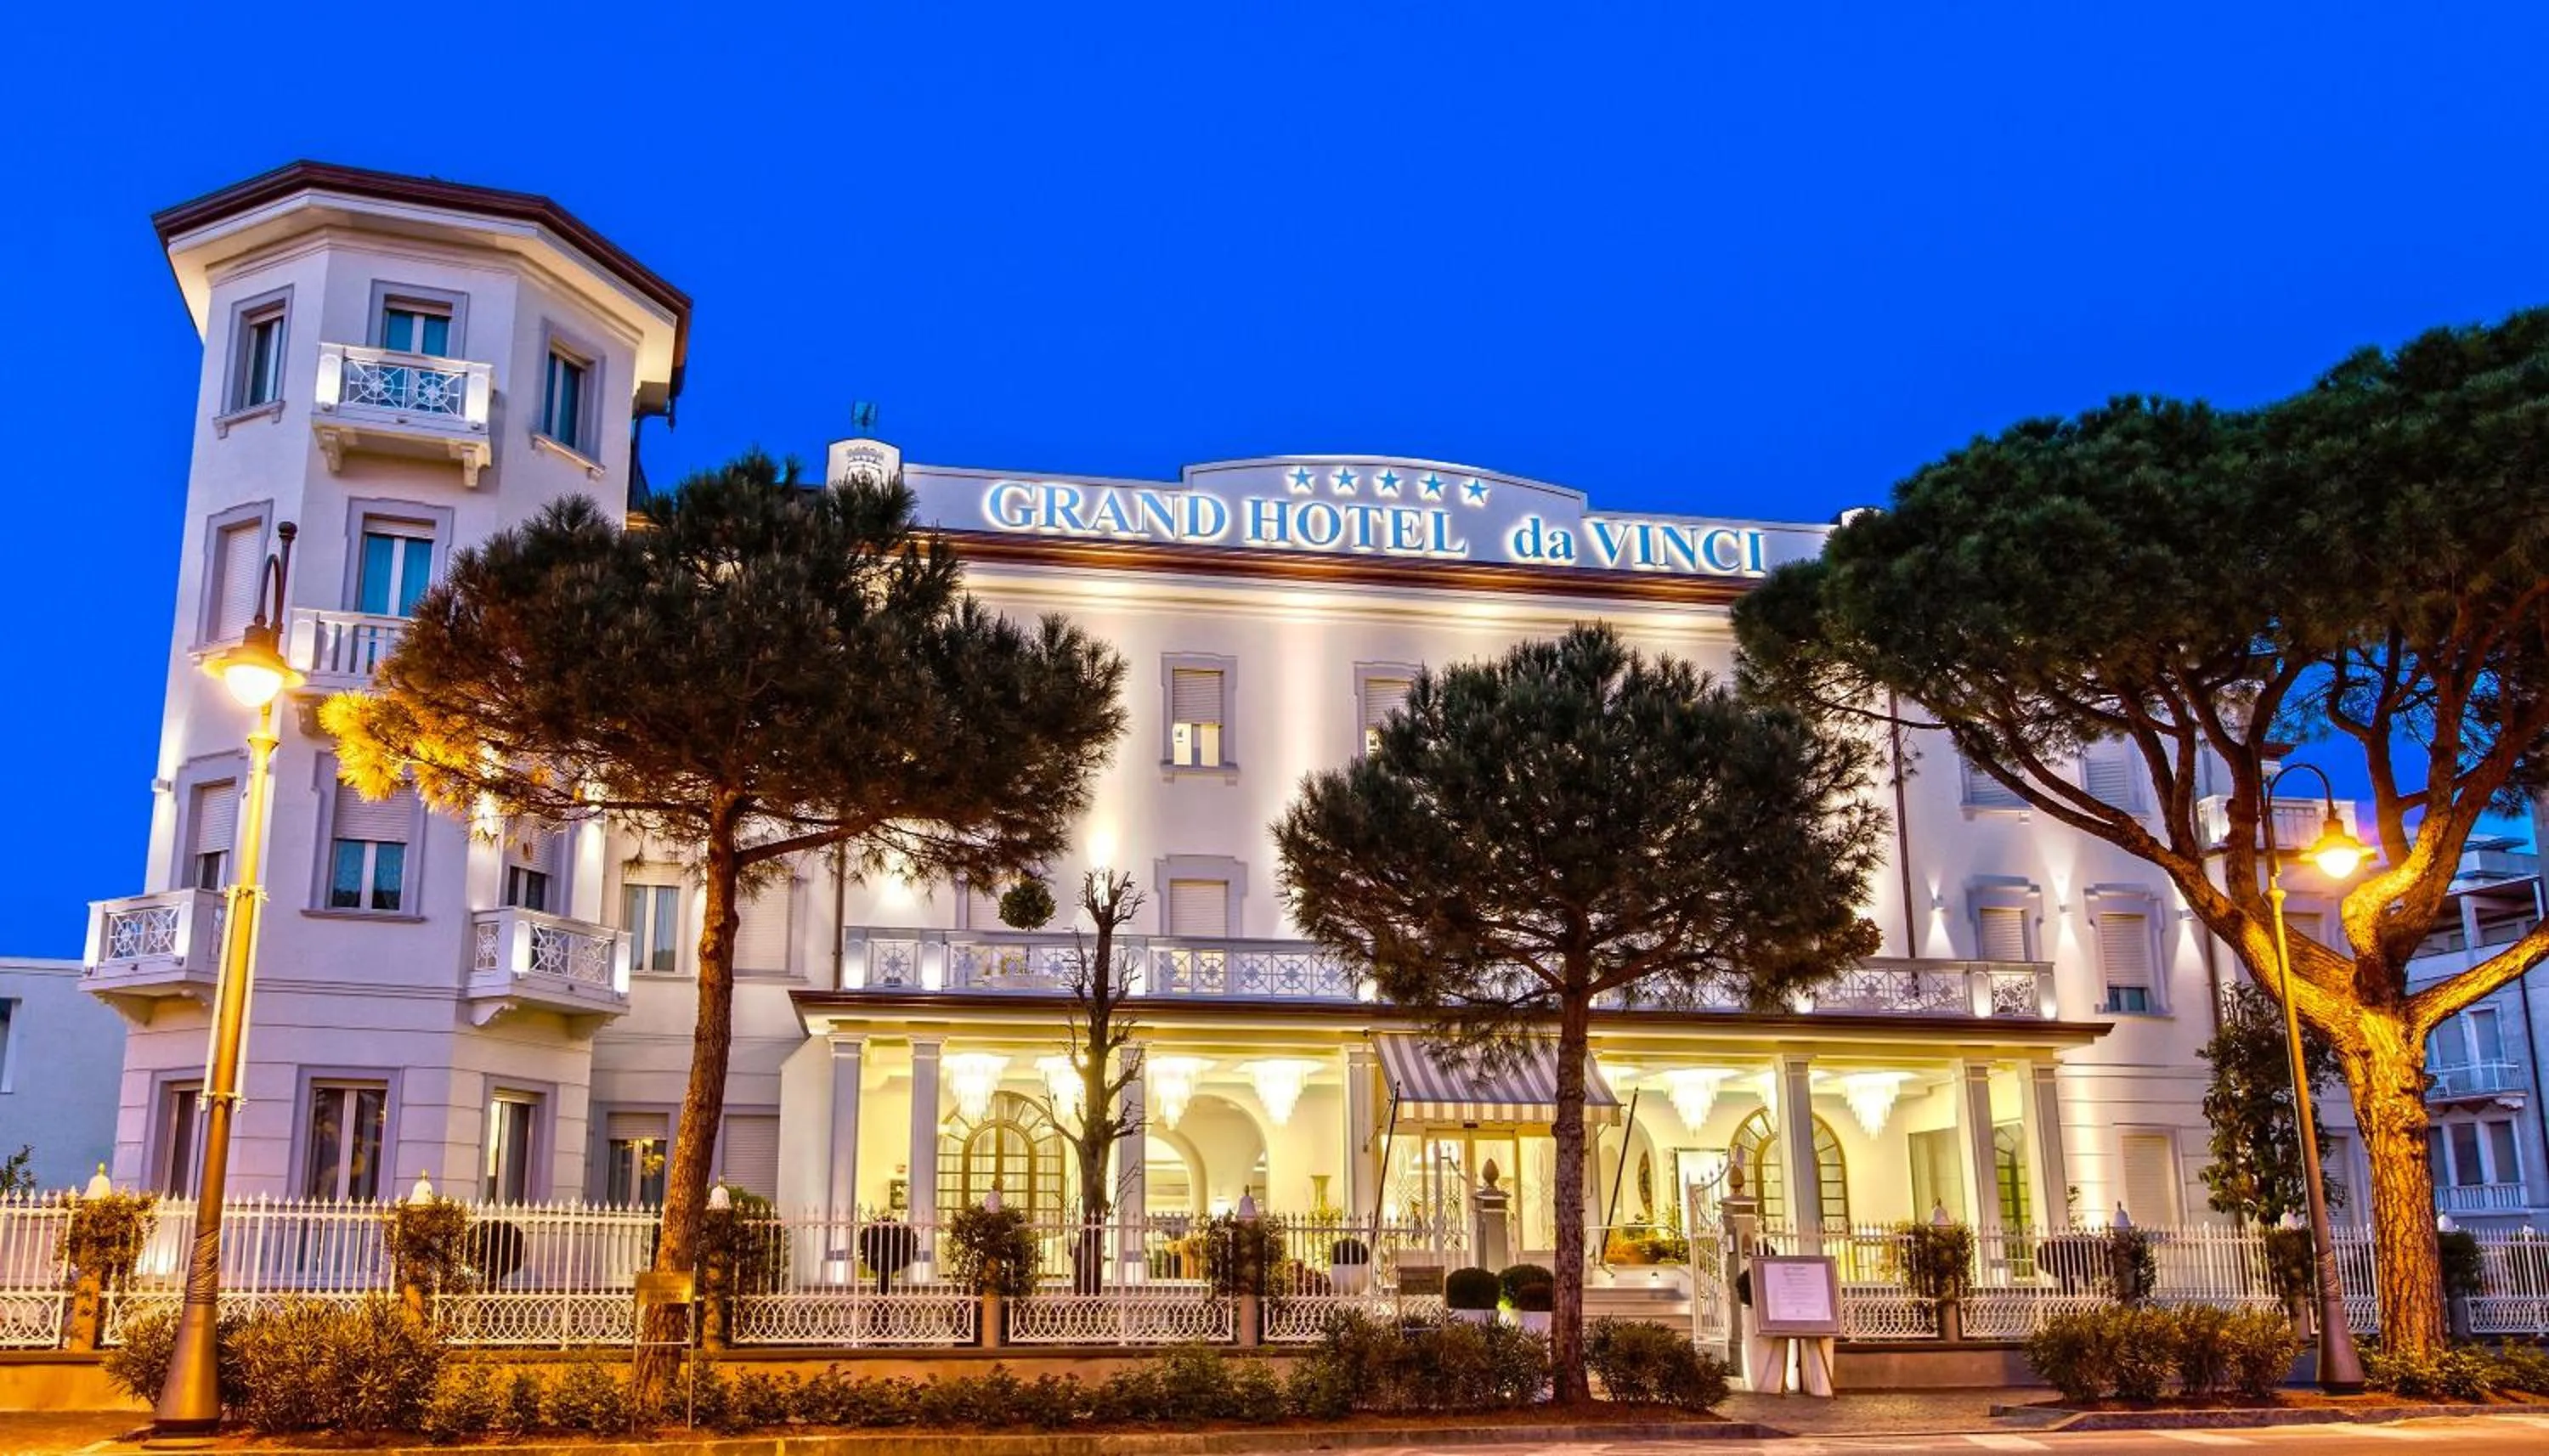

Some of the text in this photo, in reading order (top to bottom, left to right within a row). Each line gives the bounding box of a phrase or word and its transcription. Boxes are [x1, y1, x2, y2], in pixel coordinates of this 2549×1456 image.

[988, 483, 1766, 573] GRAND HOTEL da VINCI
